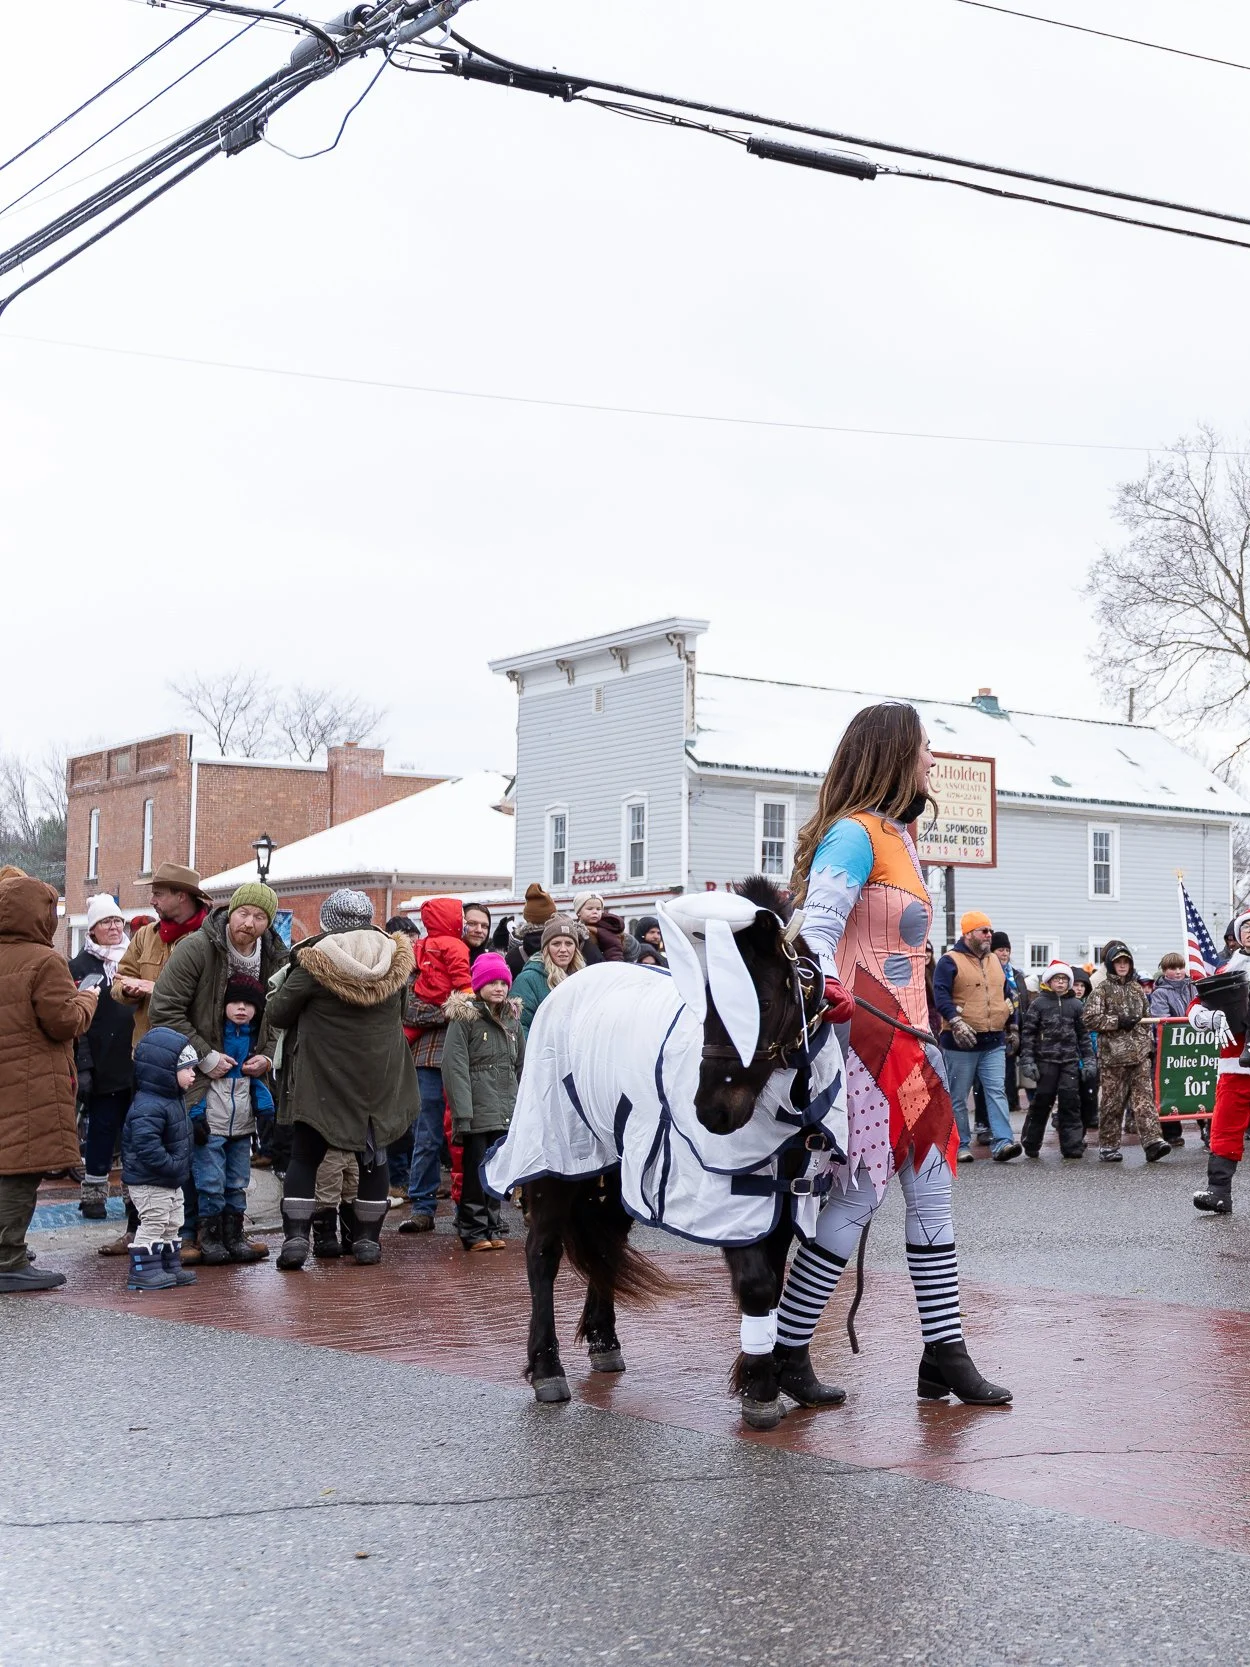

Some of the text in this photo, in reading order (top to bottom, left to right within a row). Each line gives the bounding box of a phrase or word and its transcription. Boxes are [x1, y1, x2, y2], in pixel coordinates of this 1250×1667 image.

[926, 804, 983, 818] RALTOR
[945, 823, 988, 835] SPONSORED
[919, 833, 984, 846] CARRIAGE RIDES
[1170, 1027, 1217, 1046] Hono
[1166, 1055, 1198, 1069] Police
[1184, 1075, 1211, 1097] for
